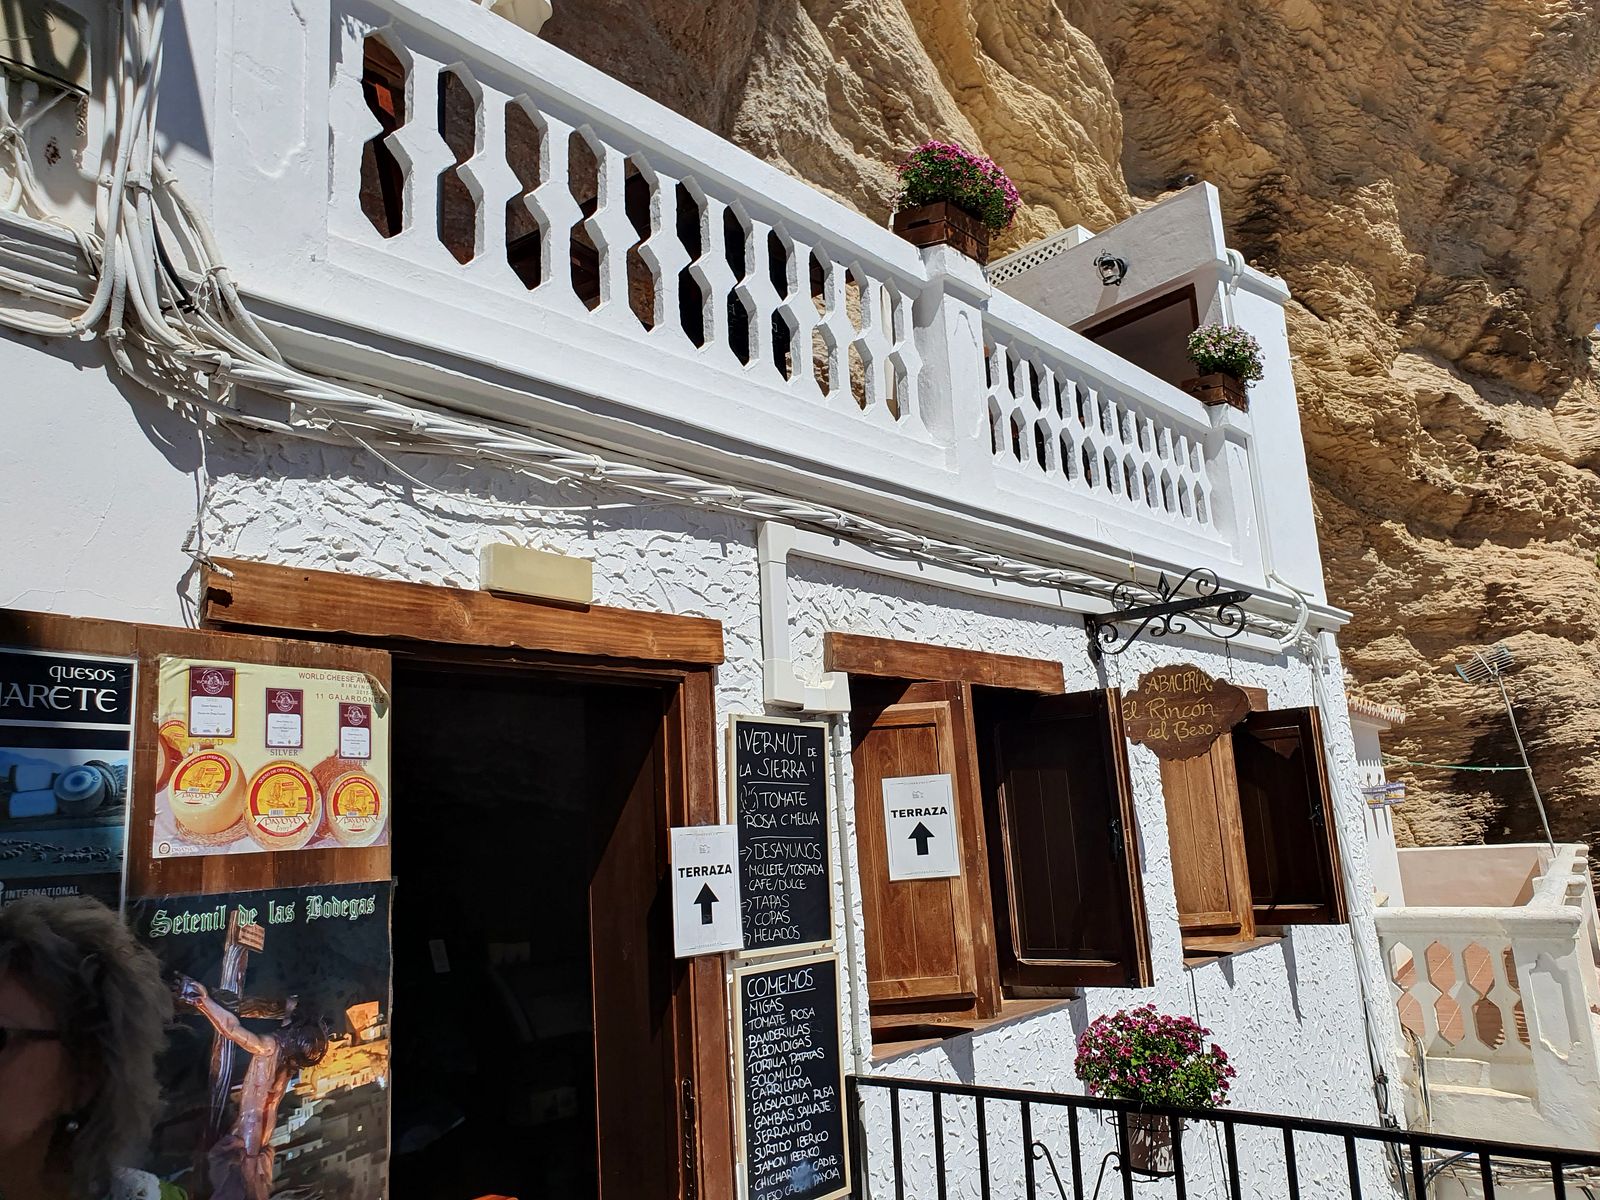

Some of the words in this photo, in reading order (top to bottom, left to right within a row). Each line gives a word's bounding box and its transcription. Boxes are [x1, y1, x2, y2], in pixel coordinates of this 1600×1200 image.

[49, 665, 116, 682] quesos
[298, 672, 325, 680] WORLD
[327, 674, 356, 682] CHEESE
[1144, 669, 1214, 694] ABACERÍA
[0, 681, 118, 713] ARETE
[328, 693, 385, 704] GALARDONES
[1122, 700, 1141, 721] El
[1145, 696, 1216, 721] Rincón
[1146, 721, 1170, 740] del
[1172, 720, 1213, 742] Beso
[807, 747, 818, 757] DE
[740, 763, 752, 777] LA
[759, 791, 808, 808] TOMATE
[743, 813, 777, 829] ROSA
[890, 806, 948, 818] TERRAZA
[754, 842, 821, 860] DESAYUNOS
[678, 864, 733, 878] TERRAZA
[5, 886, 80, 899] INTERNATIONAL
[749, 879, 807, 891] CAFE/DULCE
[752, 893, 790, 910] TAPAS
[149, 904, 227, 939] Setenil
[237, 904, 259, 928] de
[268, 900, 296, 925] las
[305, 894, 376, 923] Bodegas
[754, 909, 790, 926] COPAS
[754, 925, 801, 942] HELADOS
[747, 968, 814, 998] COMEMOS
[749, 997, 785, 1017] MIGAS
[748, 1013, 788, 1031] TOMATE
[790, 1006, 816, 1022] ROSA
[748, 1023, 811, 1049] BANDERILLAS
[748, 1035, 812, 1063] ALBONDIGAS
[748, 1056, 787, 1074] TORTILLA
[789, 1047, 825, 1065] PATATAS
[750, 1065, 802, 1088] SOLOMILLO
[751, 1076, 812, 1100] CARRILLADA
[753, 1092, 810, 1116] ENSALADILLA
[813, 1085, 835, 1100] RUSA
[754, 1107, 795, 1130] GAMBAS
[753, 1119, 812, 1145] SERRANITO
[754, 1139, 792, 1163] SURTIDO
[796, 1130, 829, 1148] IBERICO
[754, 1156, 787, 1176] JAMON
[790, 1145, 820, 1162] IBERICO
[813, 1154, 838, 1171] CADIZ
